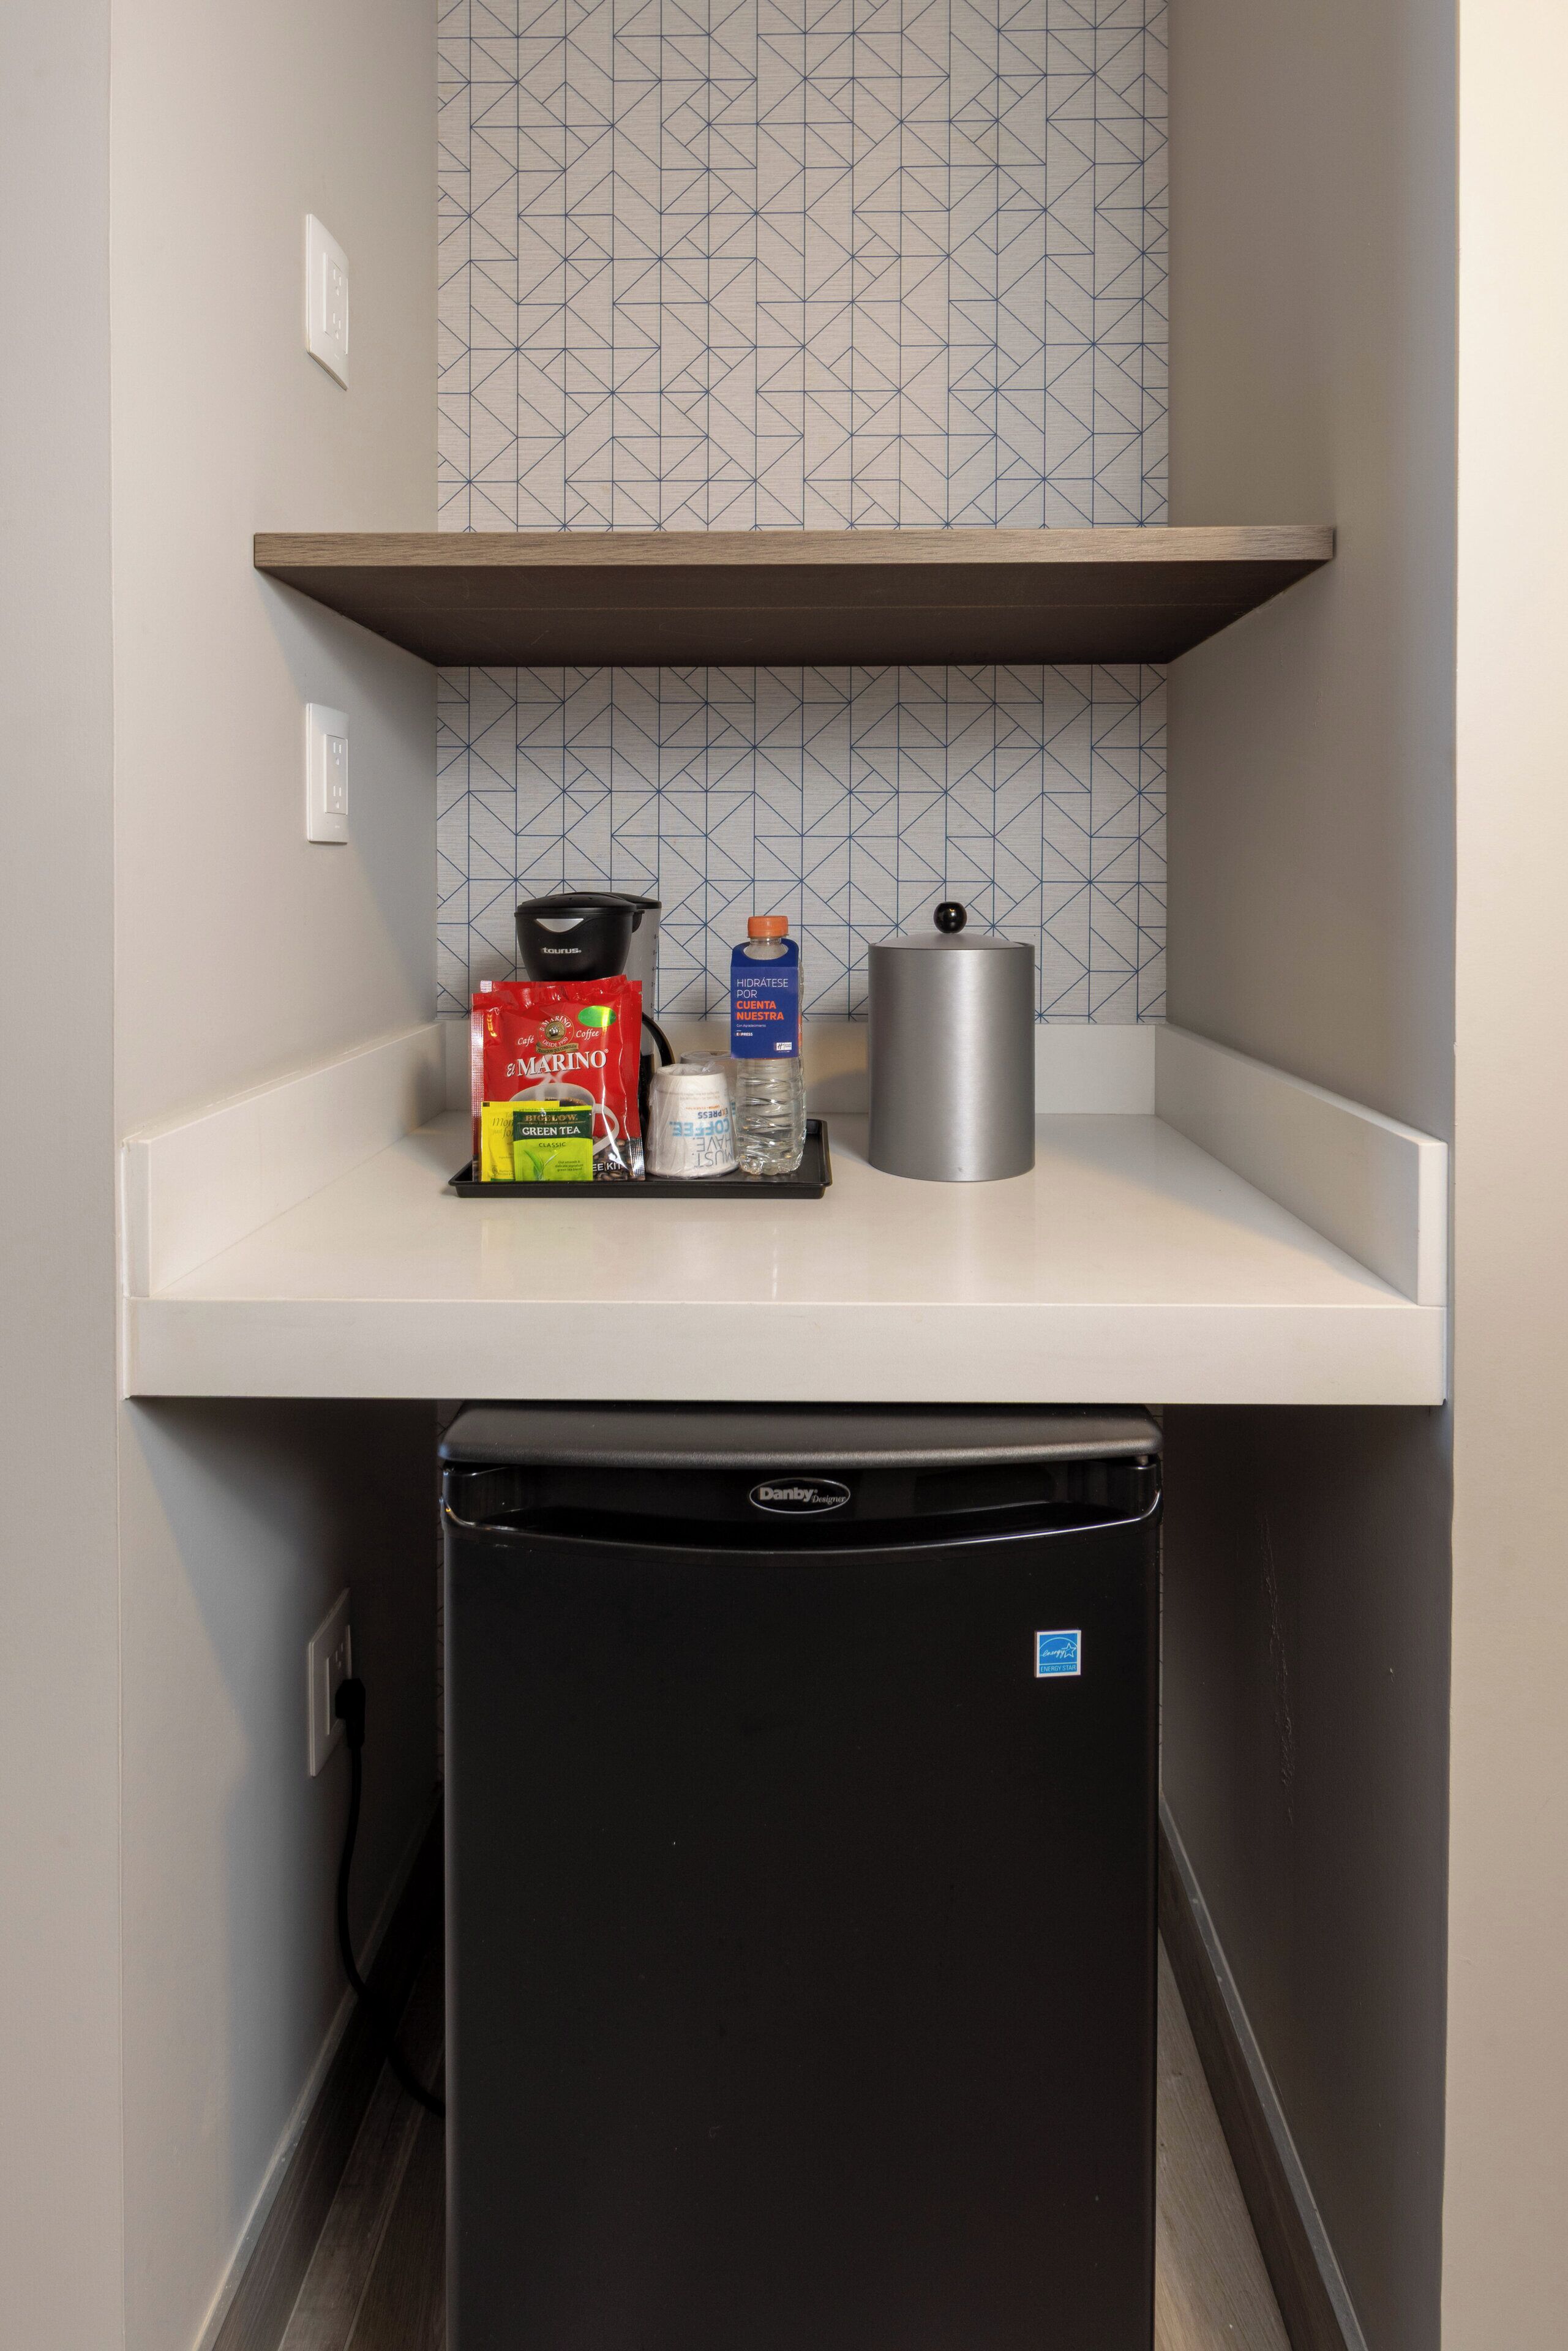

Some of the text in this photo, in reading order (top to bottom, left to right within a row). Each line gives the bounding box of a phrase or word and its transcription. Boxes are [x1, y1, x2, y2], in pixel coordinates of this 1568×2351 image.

[737, 977, 789, 988] HIDRÁTESE
[737, 989, 757, 999] POR
[737, 1000, 776, 1010] CUENTA
[737, 1011, 784, 1021] NUESTRA
[576, 1029, 599, 1040] Coffee
[517, 1035, 535, 1047] Café
[507, 1050, 607, 1077] El MARINO
[697, 1108, 728, 1119] EXPRESS
[693, 1133, 732, 1152] HAVE.
[692, 1149, 733, 1168] MUST.
[760, 1487, 846, 1505] Danby Designer
